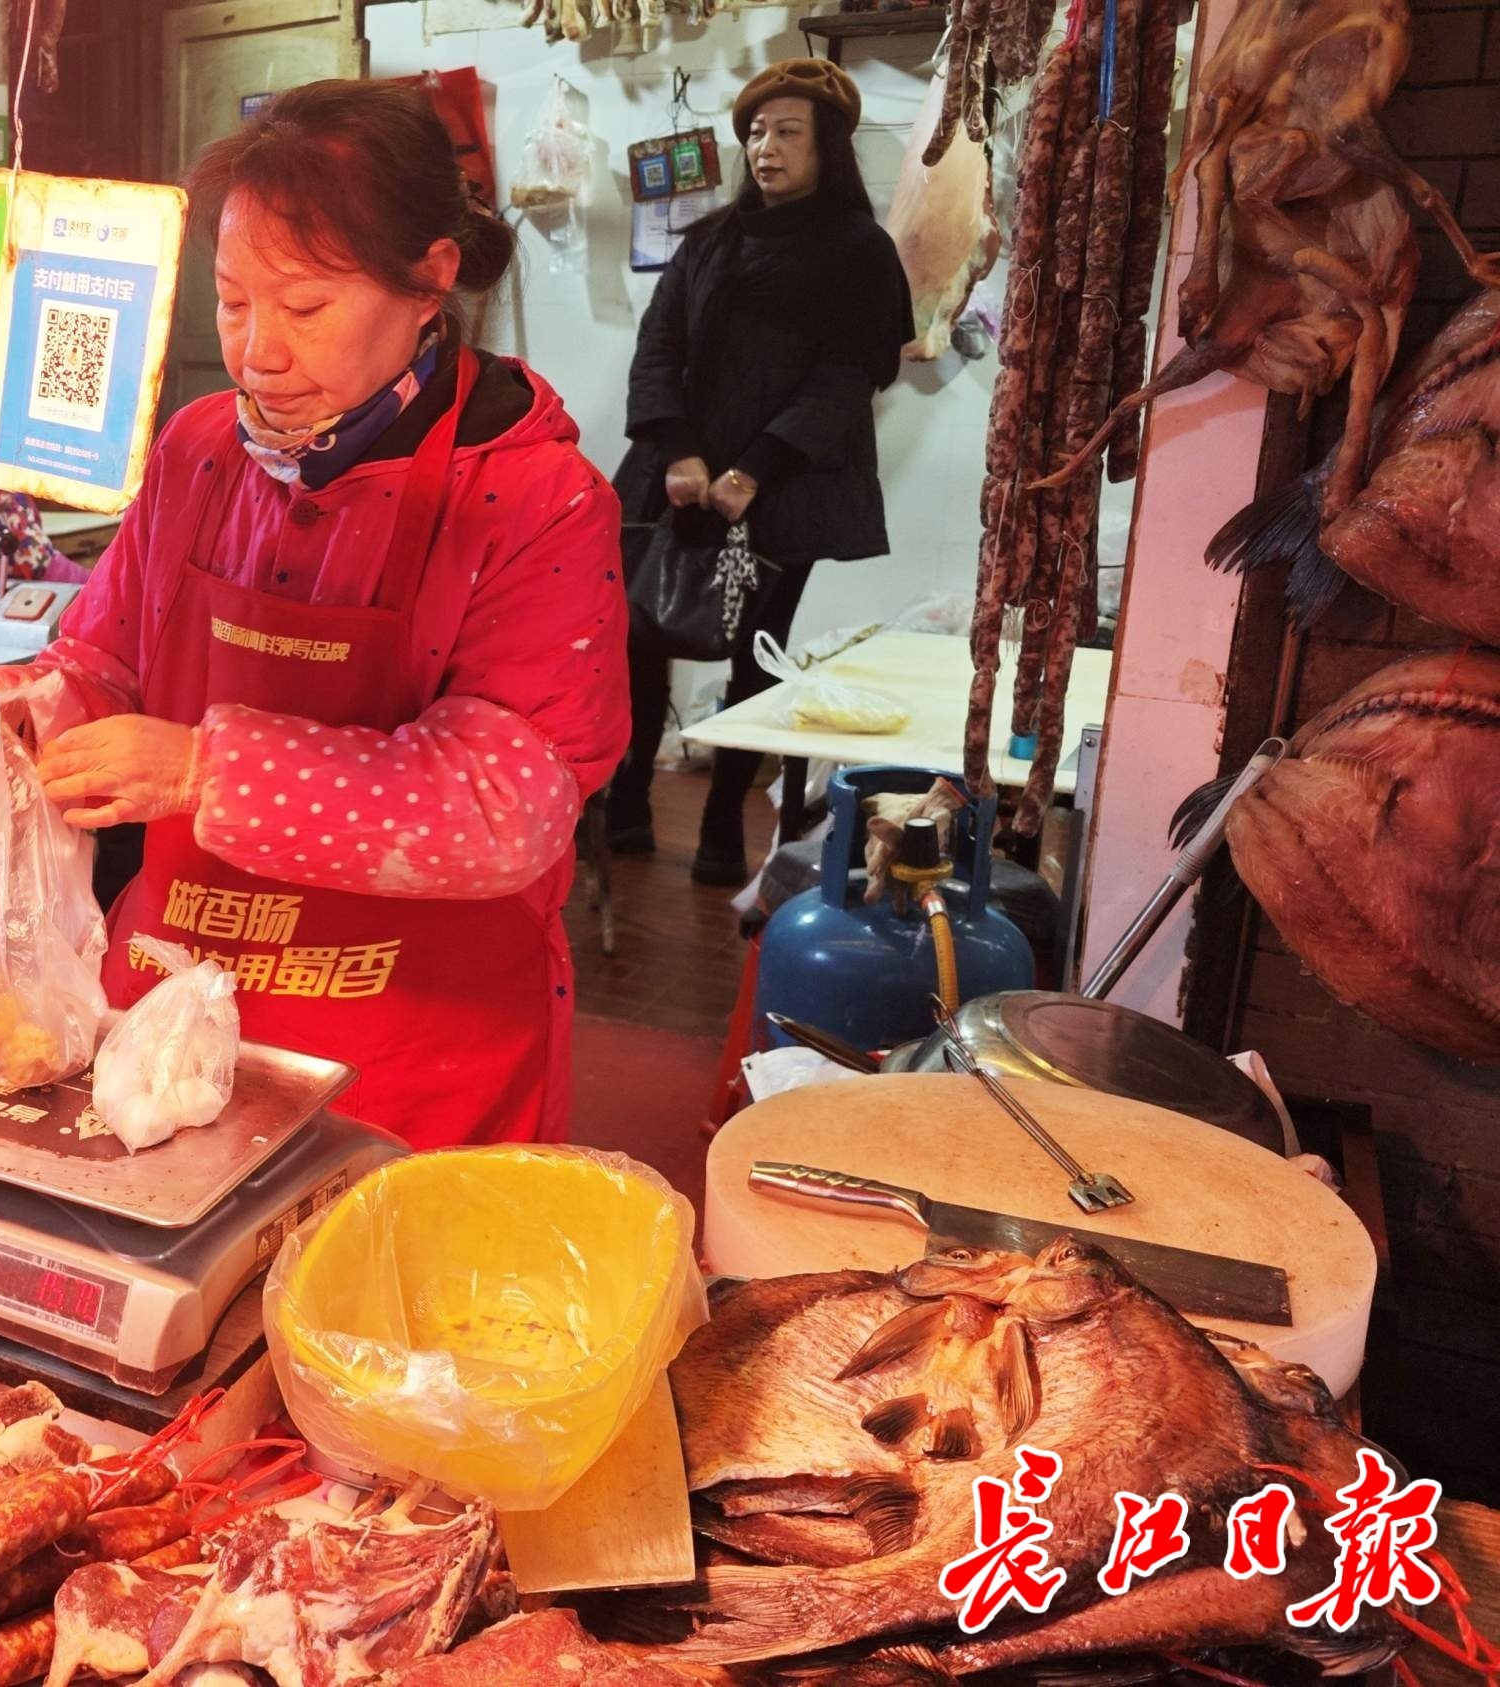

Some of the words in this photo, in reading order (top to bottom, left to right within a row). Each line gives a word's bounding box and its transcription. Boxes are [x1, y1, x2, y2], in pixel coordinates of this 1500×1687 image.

[33, 267, 135, 301] 支付就用支付宝
[162, 878, 304, 945] 做香肠
